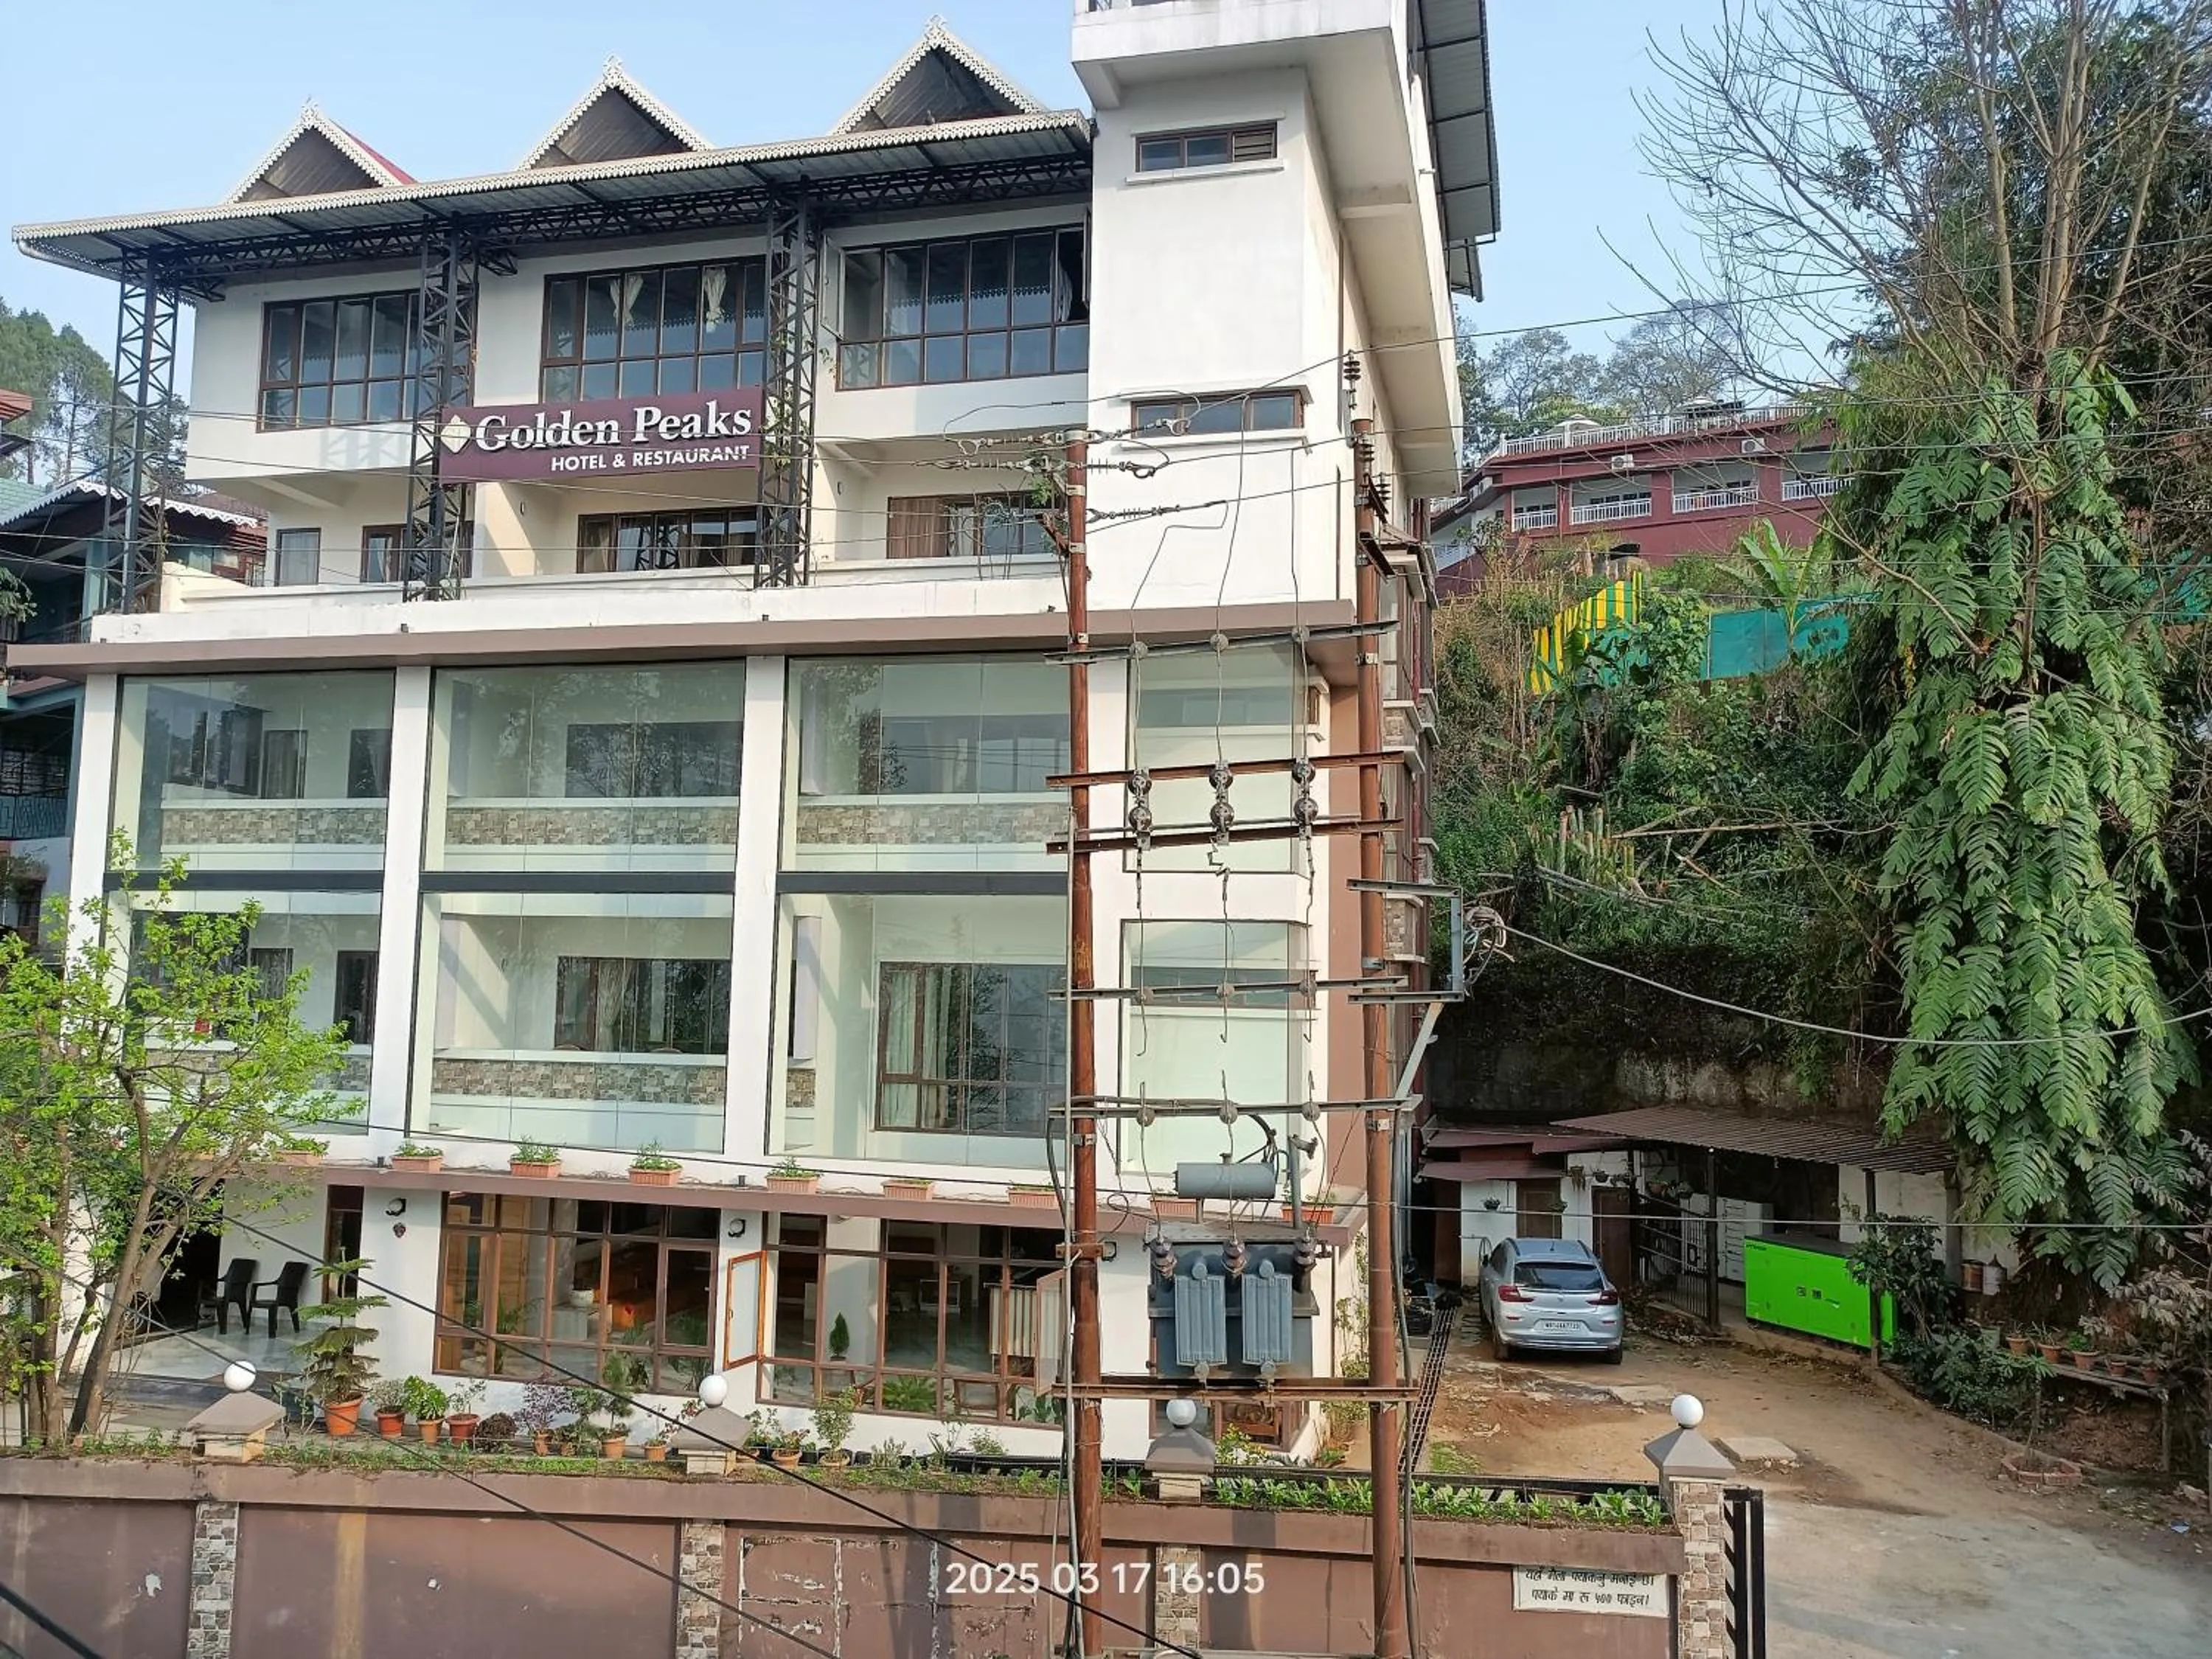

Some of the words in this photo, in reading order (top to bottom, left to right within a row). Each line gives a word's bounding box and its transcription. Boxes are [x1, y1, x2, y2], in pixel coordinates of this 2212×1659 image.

[476, 410, 621, 451] Golden
[631, 399, 753, 443] Peaks
[551, 454, 607, 472] HOTEL
[613, 453, 626, 468] &
[633, 445, 750, 467] RESTAURANT
